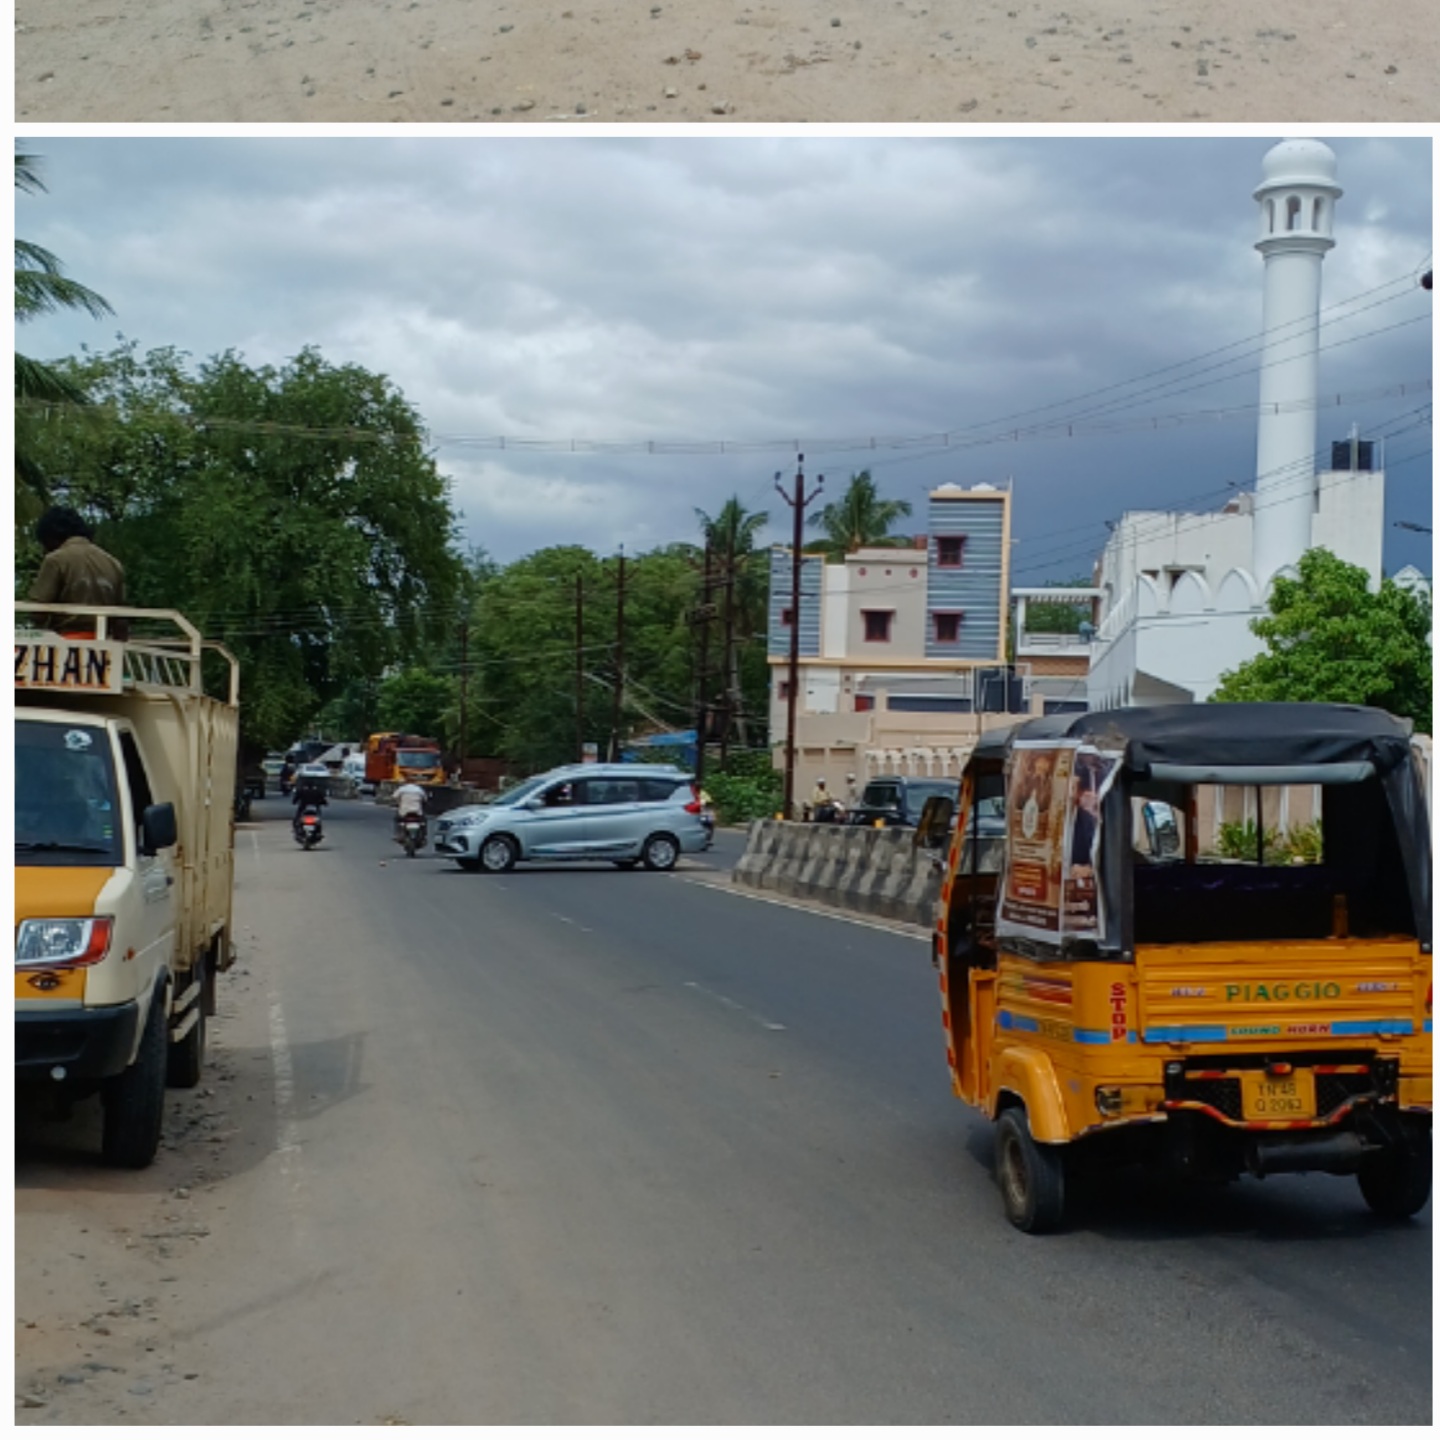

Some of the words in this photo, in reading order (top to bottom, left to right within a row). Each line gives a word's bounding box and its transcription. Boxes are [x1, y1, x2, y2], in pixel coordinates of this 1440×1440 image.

[1226, 982, 1342, 1002] PIAGGIO
[1109, 981, 1127, 1041] STOP
[1286, 1023, 1331, 1034] HORN
